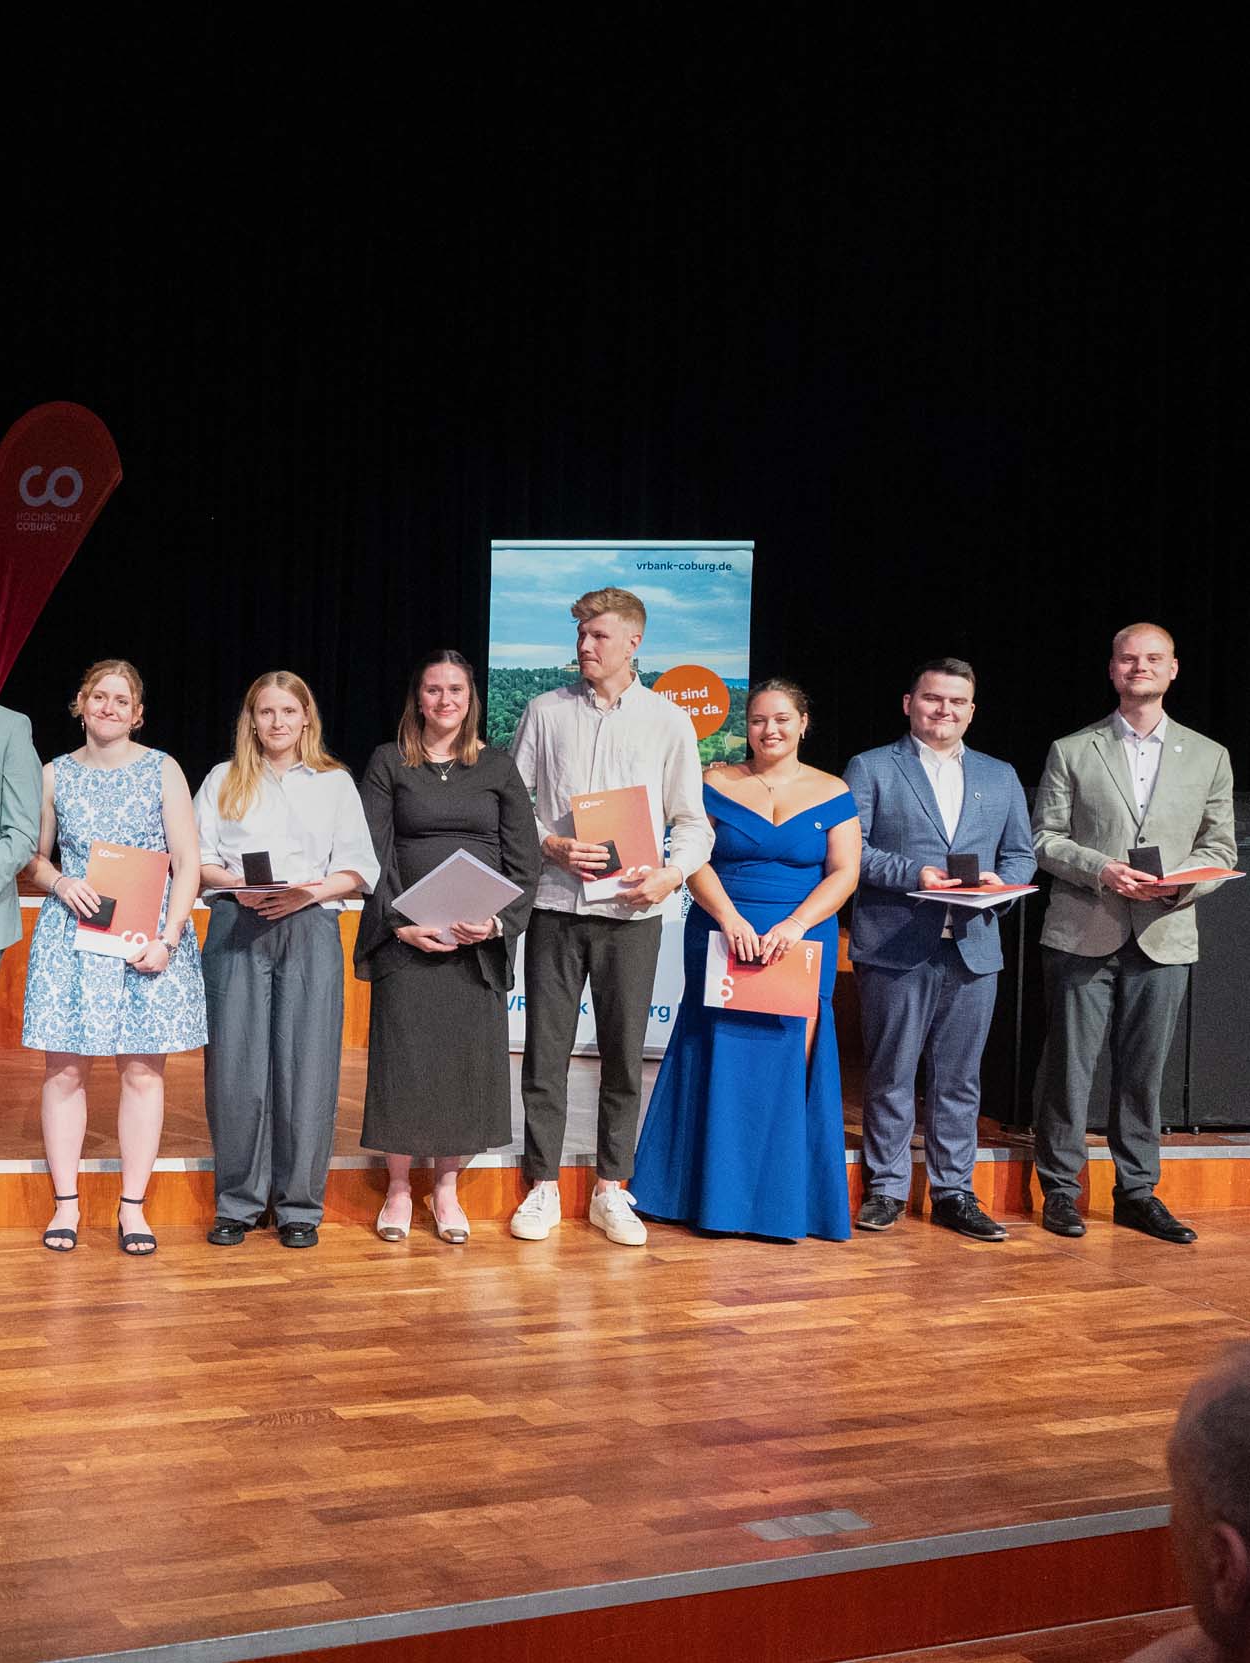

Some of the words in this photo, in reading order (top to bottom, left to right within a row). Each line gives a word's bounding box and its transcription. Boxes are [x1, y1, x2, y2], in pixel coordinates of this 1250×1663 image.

[16, 512, 81, 522] HOCHSCHULE
[16, 522, 57, 531] COBURG
[636, 561, 732, 572] vrbank-coburg.de
[681, 686, 708, 700] sind
[702, 703, 723, 715] da.
